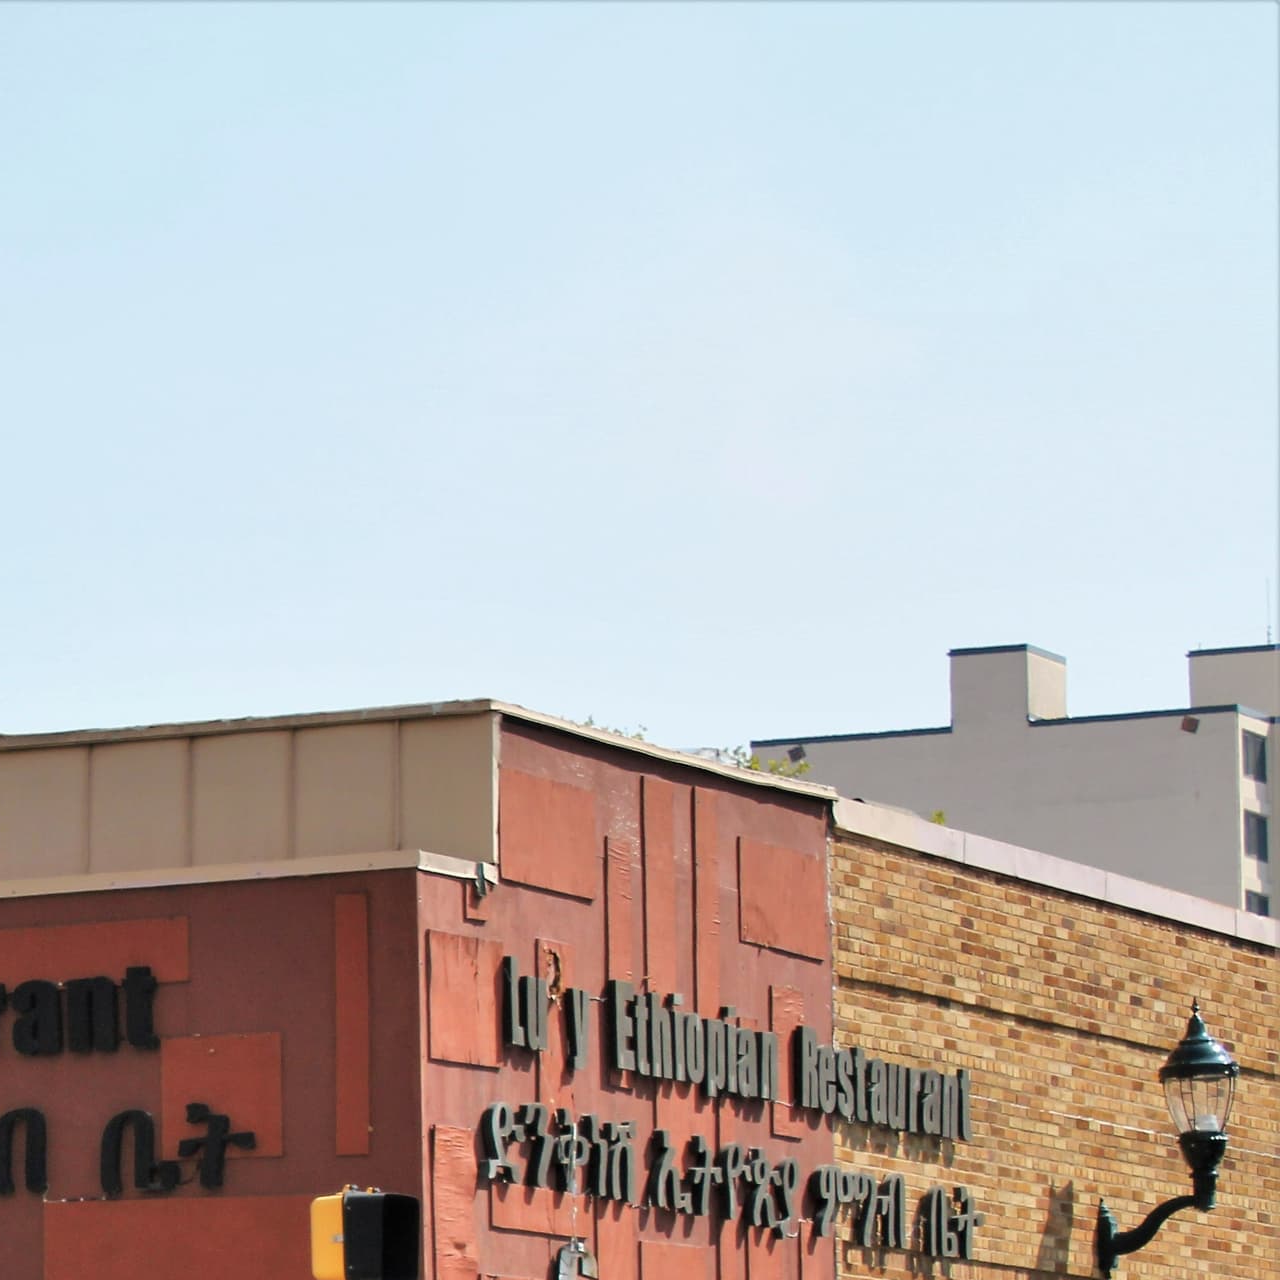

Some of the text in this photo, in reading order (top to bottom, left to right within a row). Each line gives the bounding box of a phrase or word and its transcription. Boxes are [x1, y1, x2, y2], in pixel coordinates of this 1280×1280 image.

[608, 979, 777, 1100] Ethiopian
[797, 1025, 972, 1141] Restaurant
[100, 1102, 257, 1196] ቤት
[927, 1185, 984, 1261] ቤት
